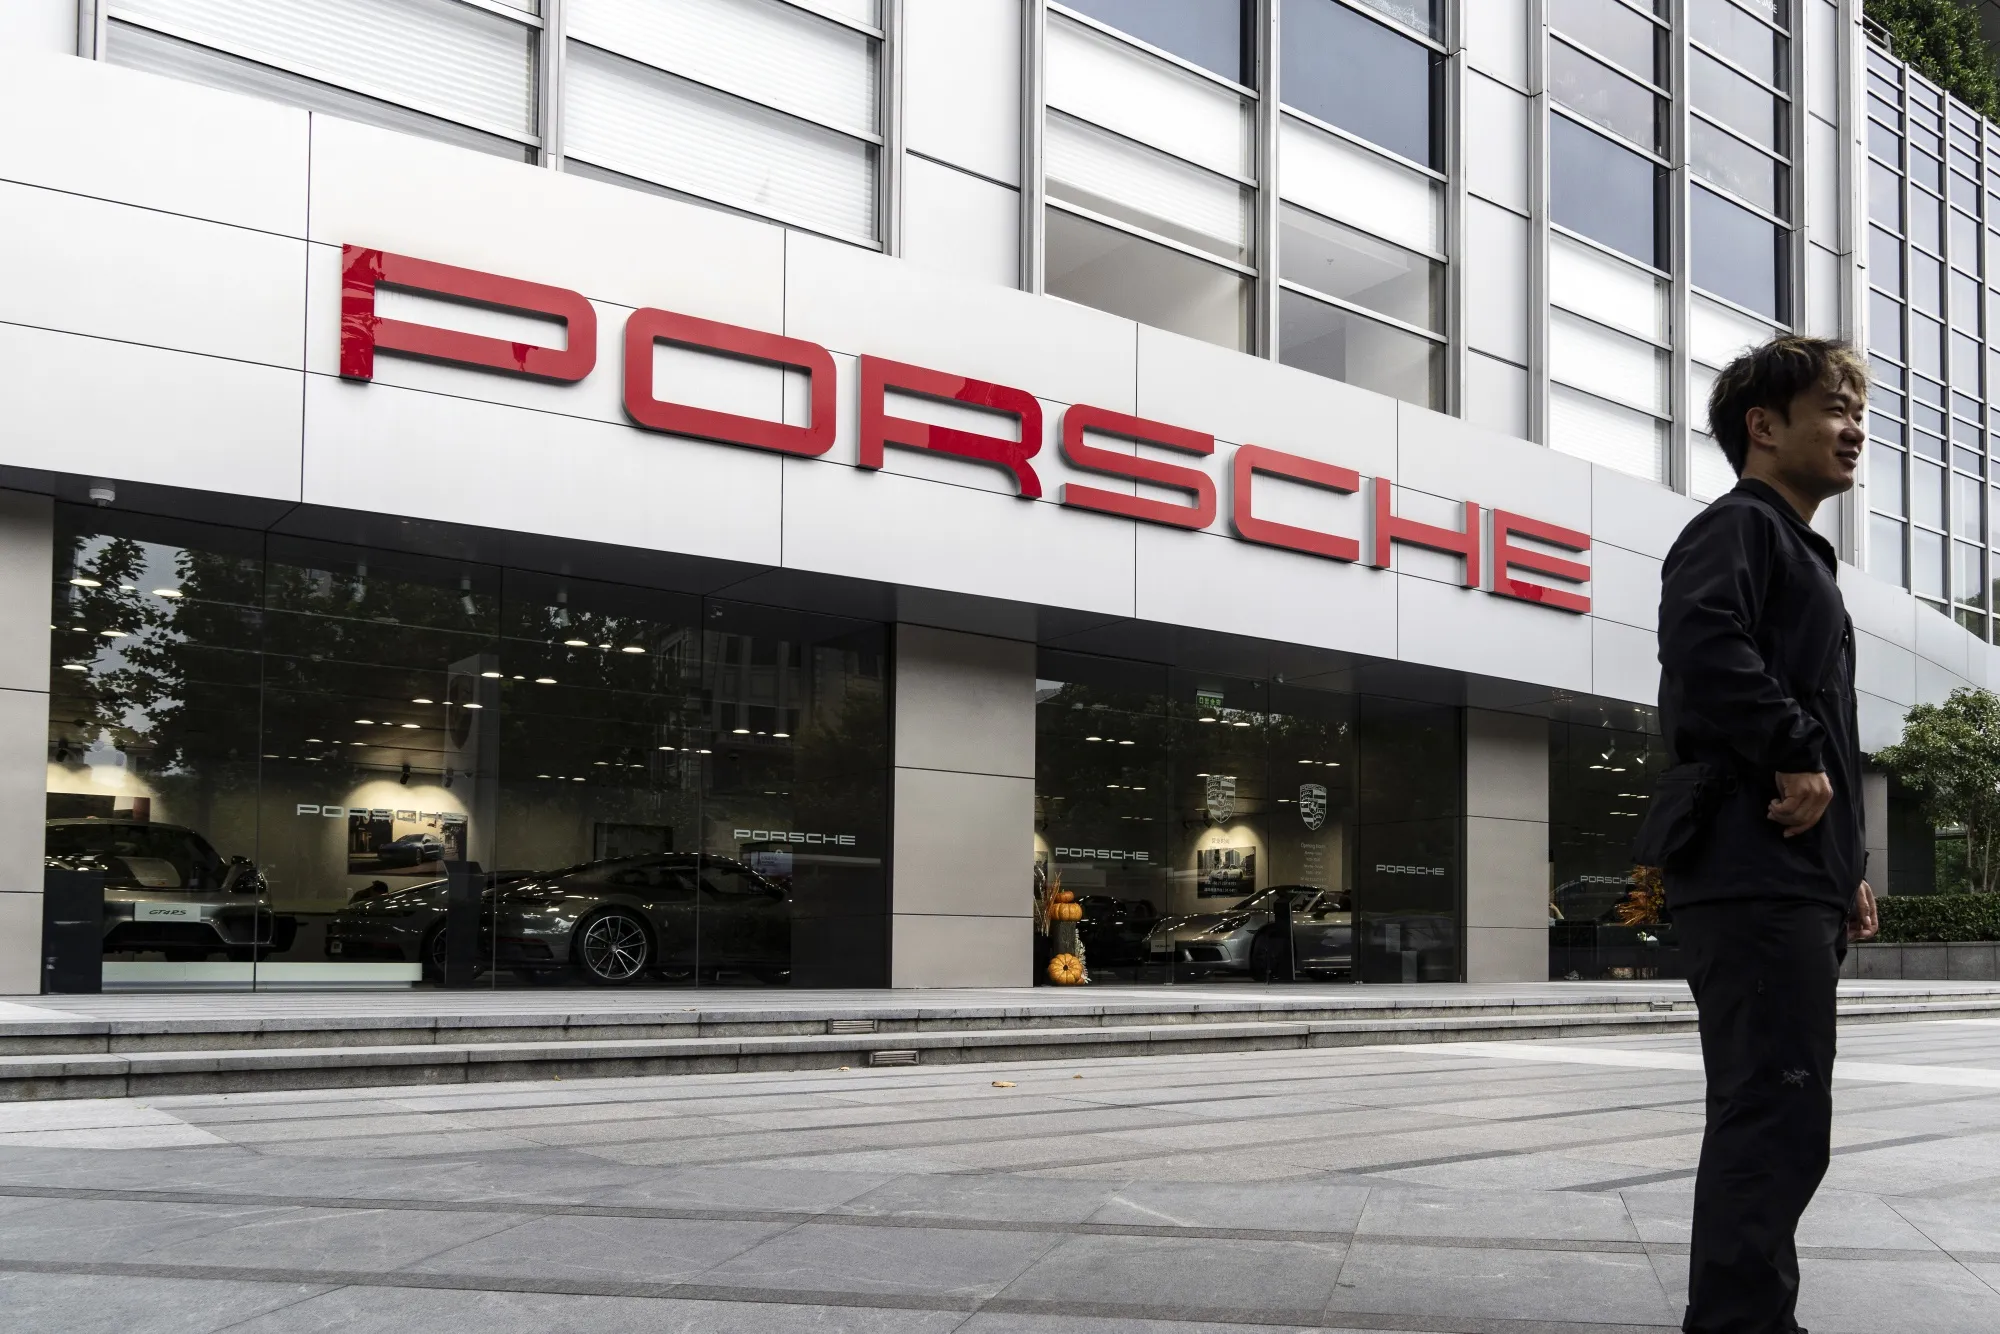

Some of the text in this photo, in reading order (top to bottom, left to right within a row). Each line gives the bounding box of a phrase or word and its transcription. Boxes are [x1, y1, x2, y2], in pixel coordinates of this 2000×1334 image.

[340, 244, 1592, 614] PORSCHE
[297, 803, 468, 824] PORSCHE
[734, 829, 856, 845] PORSCHE
[1055, 847, 1149, 861] PORSCHE
[1376, 864, 1445, 876] PORSCHE
[1580, 875, 1636, 885] PORSCHE
